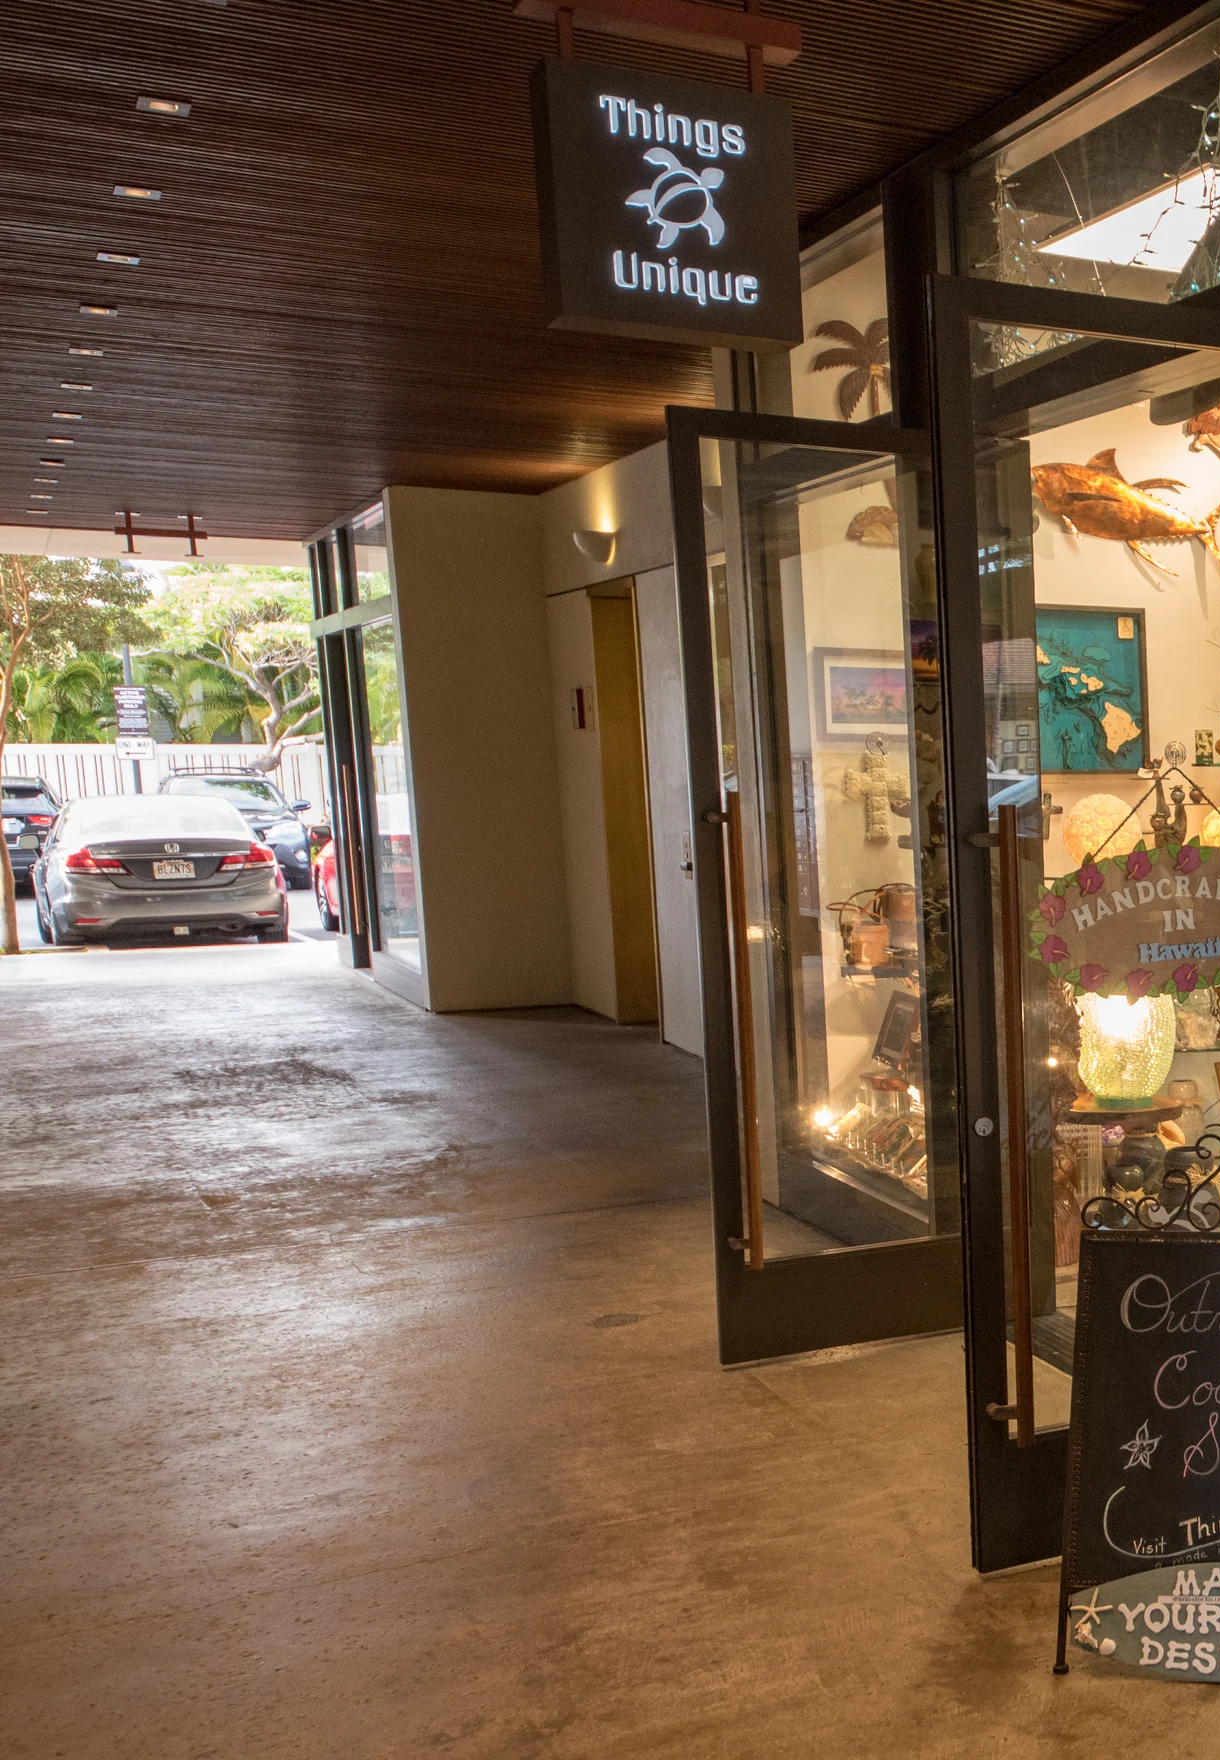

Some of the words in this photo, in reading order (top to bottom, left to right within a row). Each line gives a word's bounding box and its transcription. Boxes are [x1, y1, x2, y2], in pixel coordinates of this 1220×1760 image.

[599, 94, 746, 157] Things
[612, 249, 759, 305] Unique
[118, 741, 131, 749] ONE
[136, 741, 150, 749] WAY
[1162, 909, 1196, 932] IN
[1133, 1536, 1167, 1554] Visit
[1172, 1551, 1208, 1566] made
